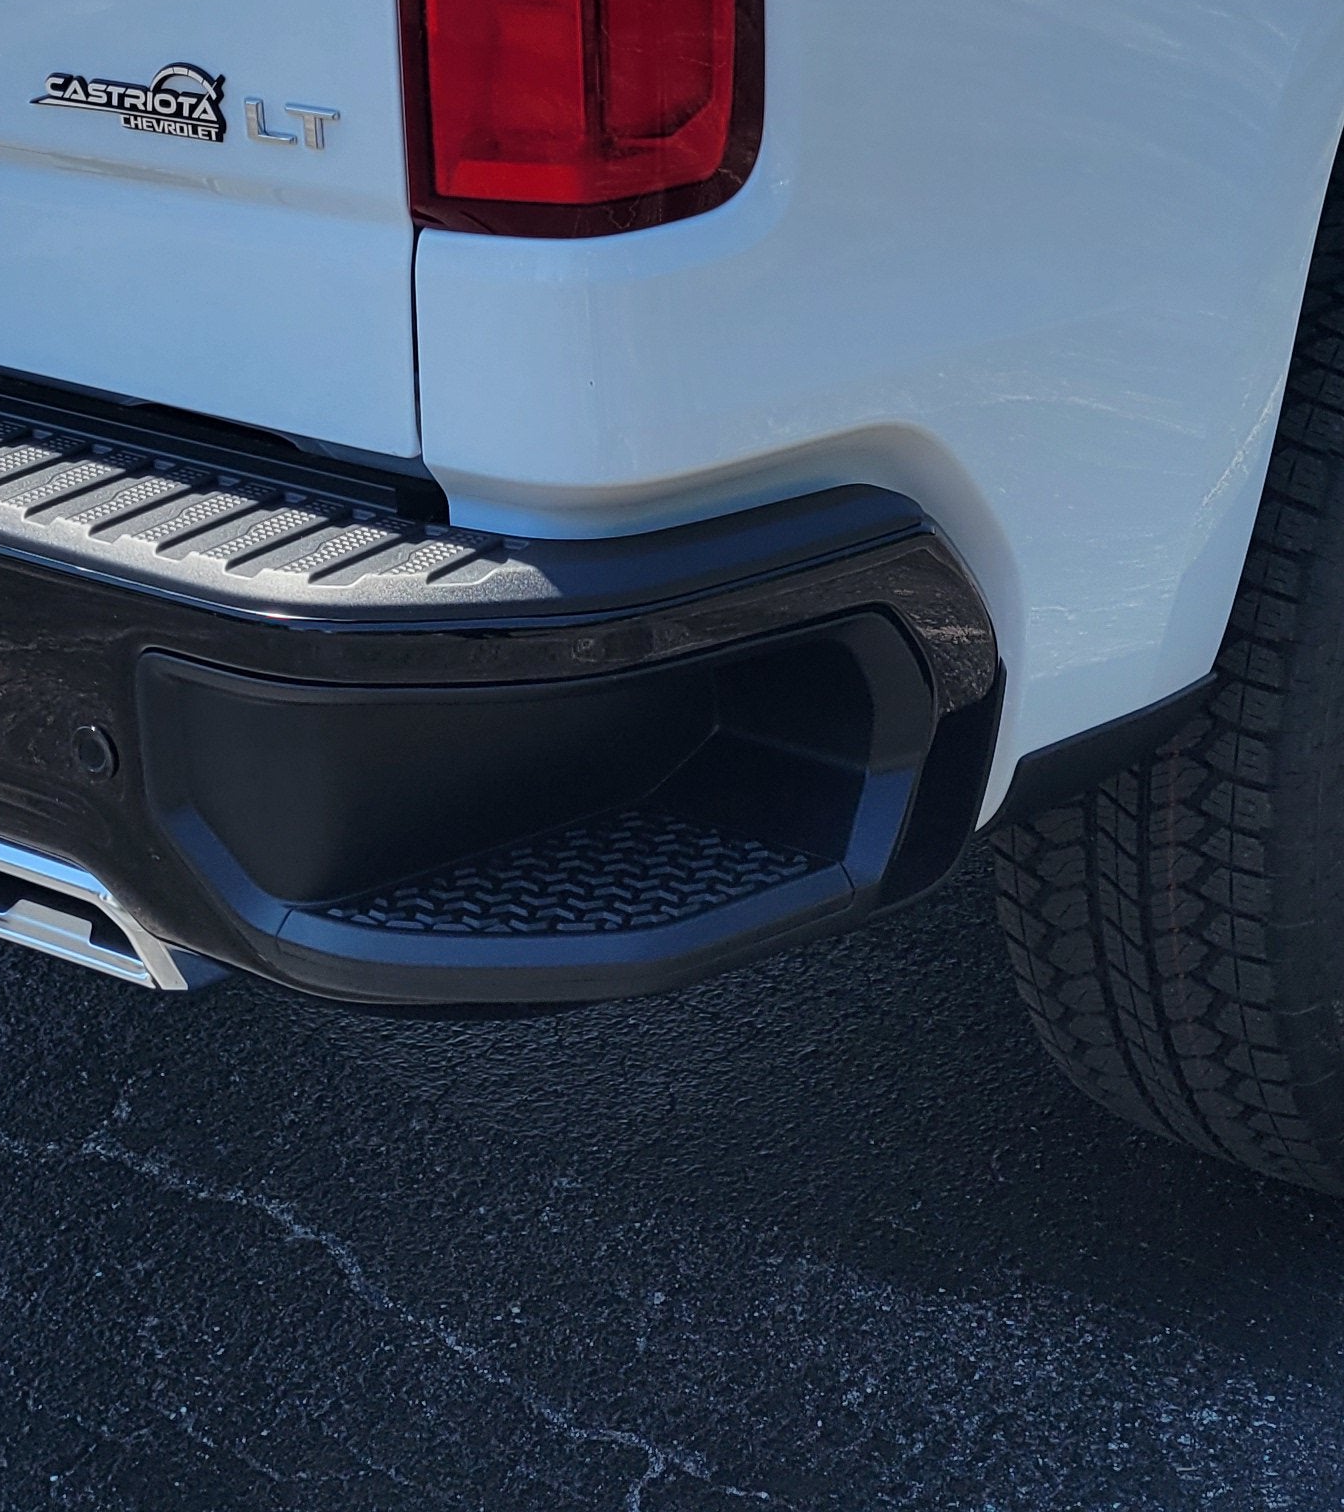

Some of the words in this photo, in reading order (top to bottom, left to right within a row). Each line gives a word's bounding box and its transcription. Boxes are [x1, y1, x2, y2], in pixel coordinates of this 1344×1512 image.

[44, 75, 218, 122] CASTRIOTA
[120, 113, 220, 141] CHEVROLET
[244, 96, 341, 149] LT
